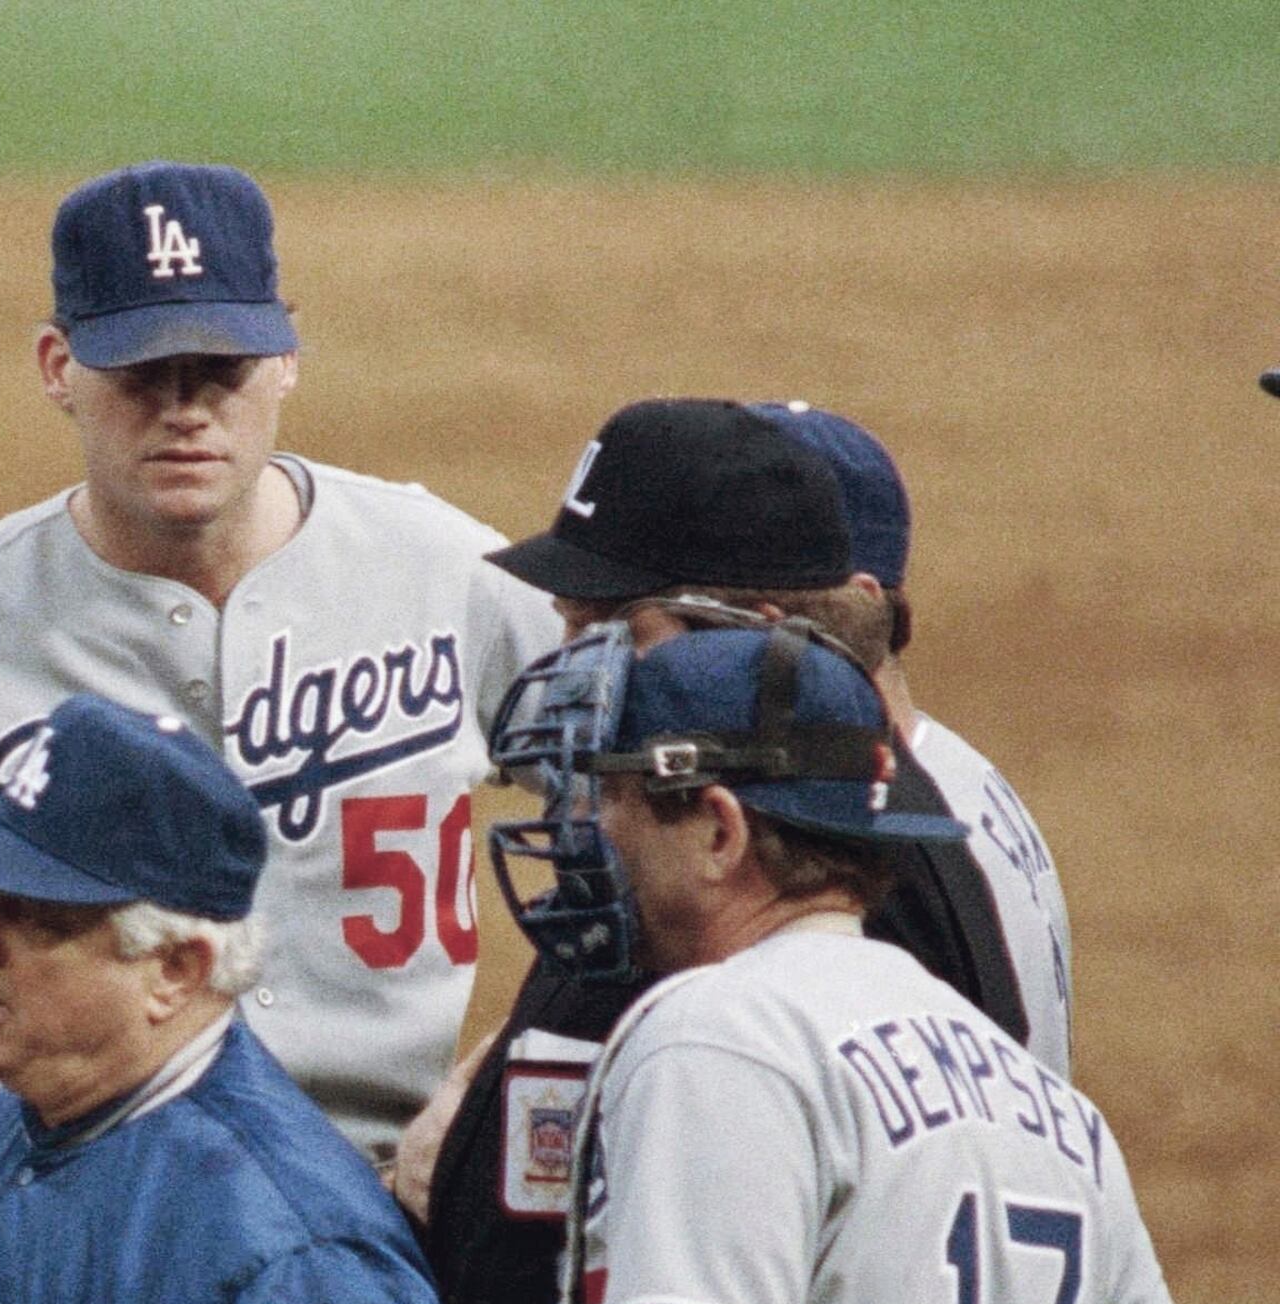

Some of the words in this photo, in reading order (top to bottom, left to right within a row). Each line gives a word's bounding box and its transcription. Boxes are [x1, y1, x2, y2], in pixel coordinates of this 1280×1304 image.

[143, 204, 203, 278] LA
[562, 439, 603, 518] L
[340, 793, 479, 970] 50
[837, 1015, 1103, 1192] DEMPSEY
